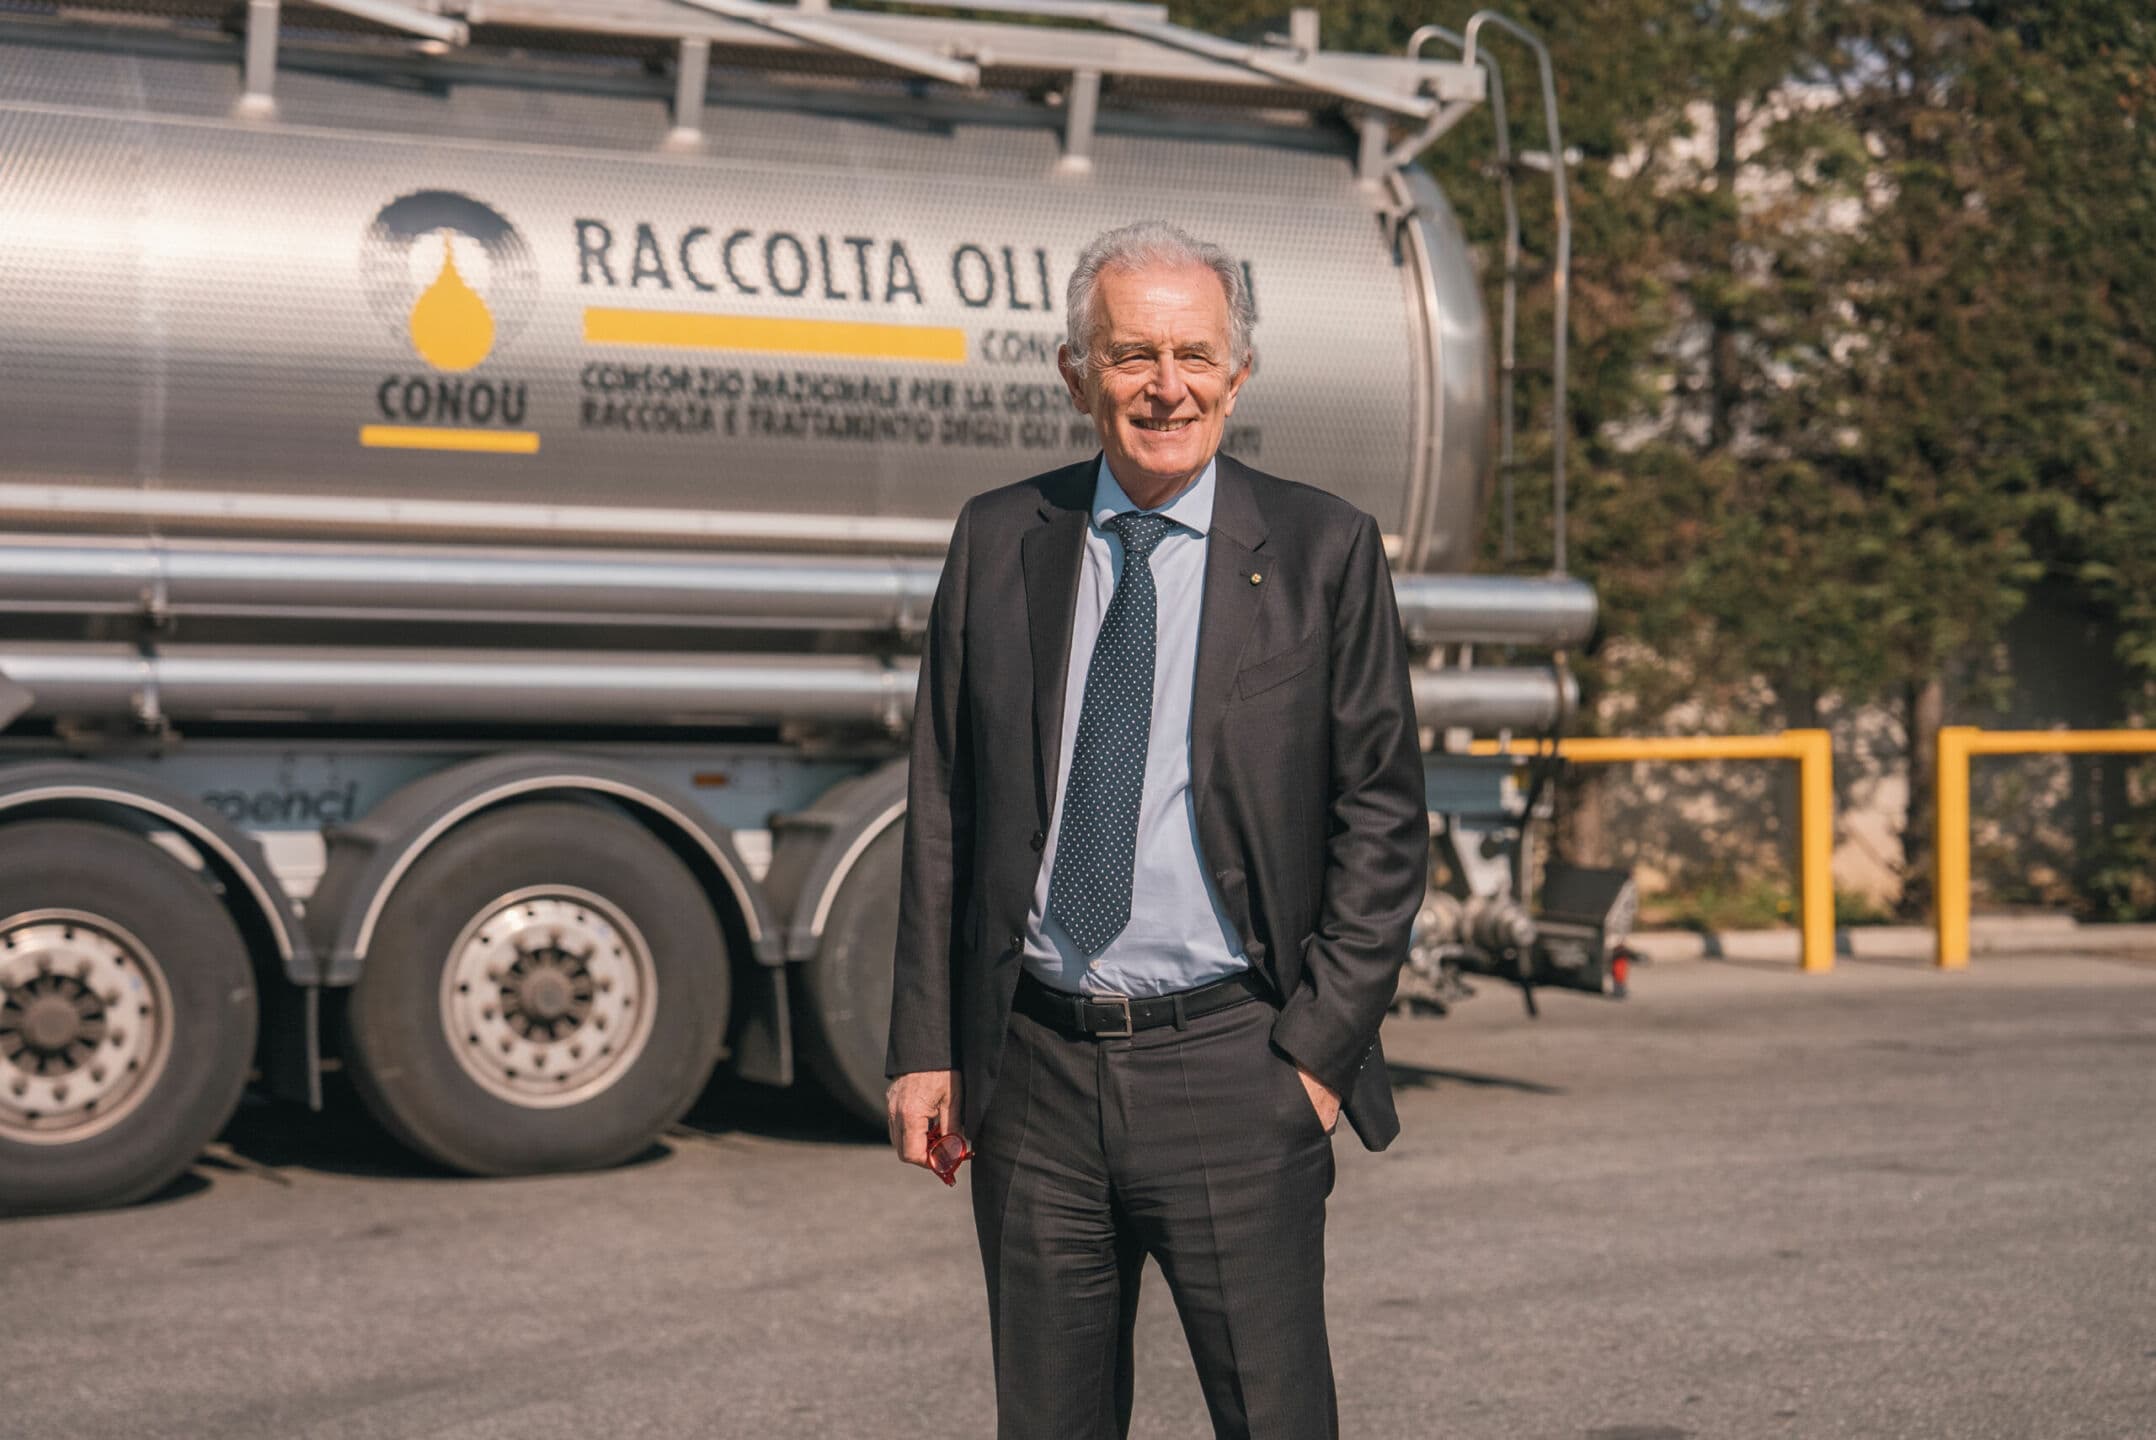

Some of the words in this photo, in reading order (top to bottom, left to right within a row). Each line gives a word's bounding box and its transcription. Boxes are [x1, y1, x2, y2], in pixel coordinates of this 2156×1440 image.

[575, 218, 922, 305] RACCOLTA
[952, 243, 1052, 311] OLI
[377, 374, 528, 425] CONOU
